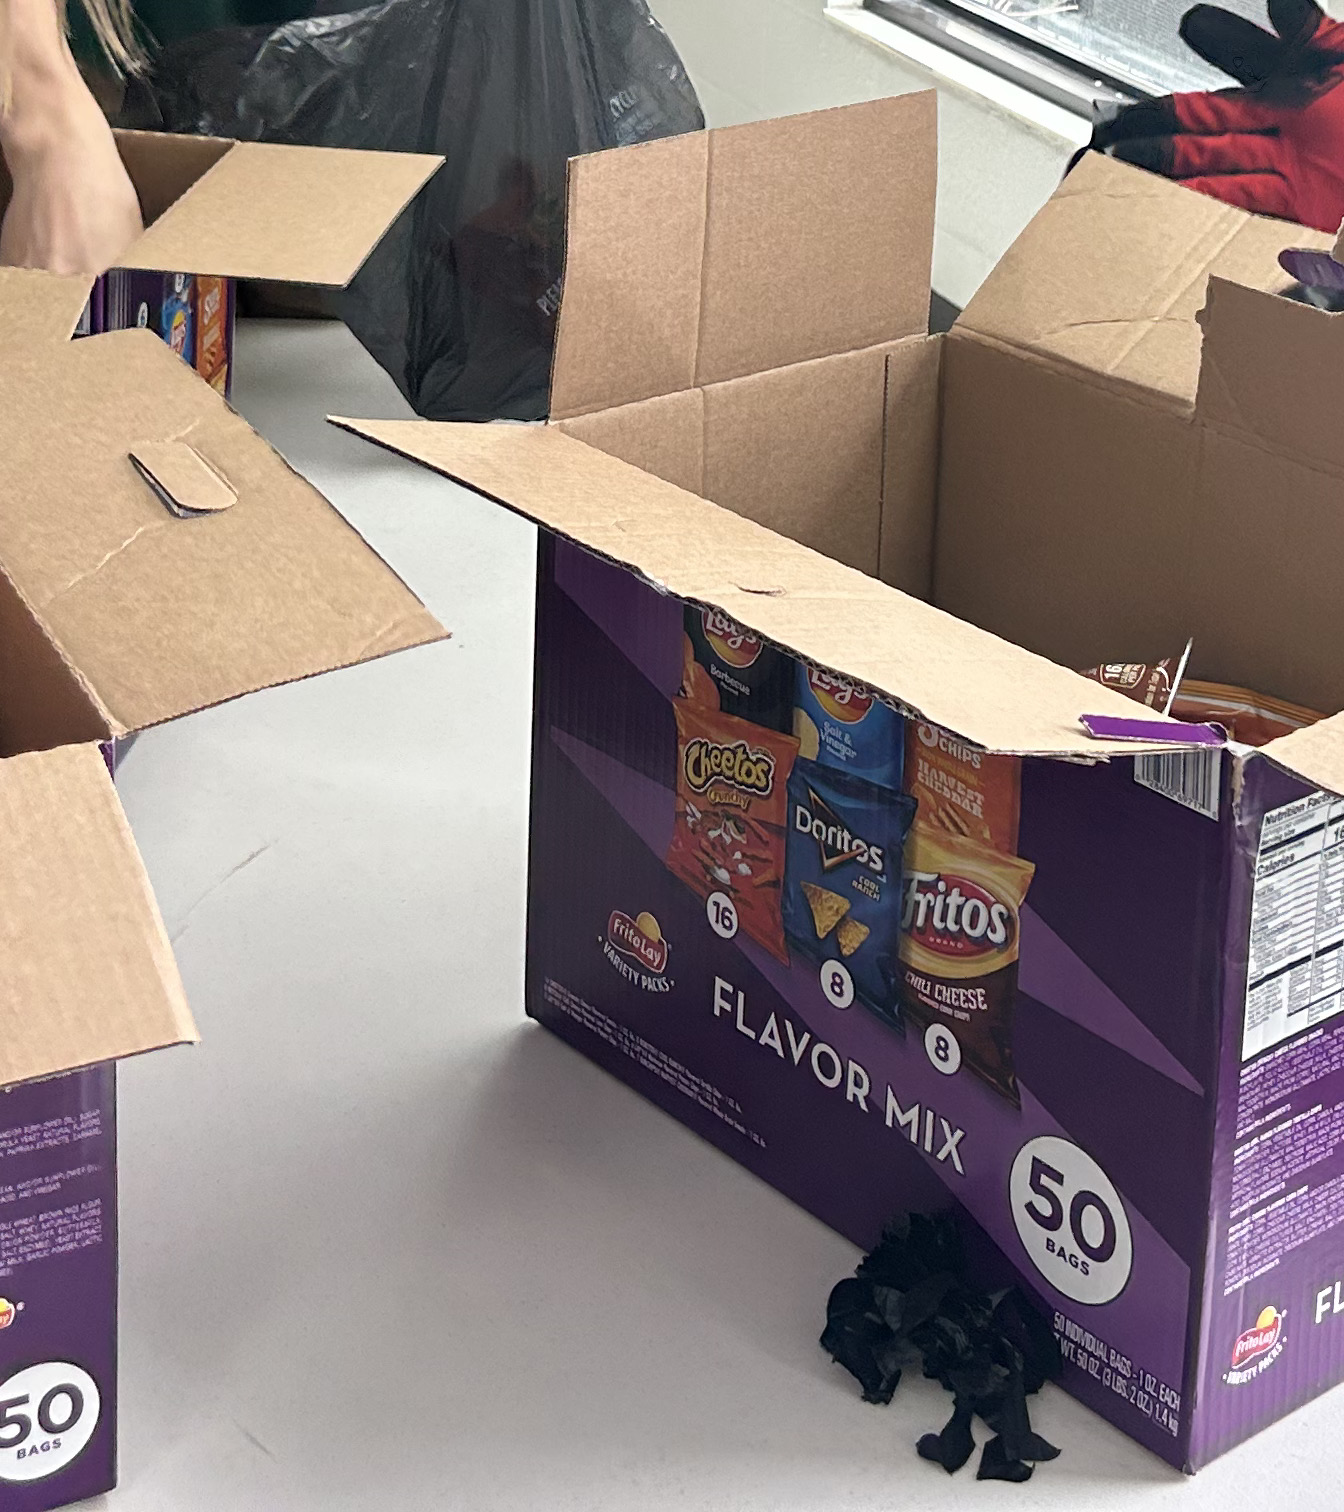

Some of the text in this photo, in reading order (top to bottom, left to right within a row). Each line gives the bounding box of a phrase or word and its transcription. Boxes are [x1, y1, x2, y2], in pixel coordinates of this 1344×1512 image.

[710, 664, 750, 695] Barbecue
[820, 730, 857, 758] Vinegar
[823, 721, 852, 745] Salt &
[684, 738, 772, 793] Cheetos
[939, 738, 982, 769] CHIPS
[917, 759, 985, 804] HARVEST
[917, 772, 984, 819] CHEDDAR
[708, 790, 751, 810] Crunchy
[1265, 802, 1305, 826] Nutrition
[795, 805, 884, 872] Doritos
[1257, 853, 1295, 876] Calories
[852, 880, 880, 901] RANCH
[859, 875, 880, 892] COOL
[712, 900, 733, 931] 16
[902, 870, 1009, 944] Fritos
[603, 941, 670, 992] VARIETY PACKS
[830, 973, 844, 997] 8
[906, 970, 988, 1011] CHILI CHEESE
[934, 1035, 950, 1063] 8
[713, 975, 870, 1113] FLAVOR
[885, 1084, 966, 1176] MIX
[1024, 1155, 1116, 1263] 50
[1046, 1237, 1091, 1277] BAGS
[1065, 1319, 1109, 1363] INDIVIDUAL
[1109, 1348, 1132, 1378] BAGS
[1139, 1369, 1144, 1387] 1
[1158, 1383, 1181, 1412] EACH
[1076, 1350, 1088, 1370] 50
[1102, 1367, 1112, 1387] (3
[1111, 1372, 1129, 1399] LBS.
[1129, 1385, 1136, 1404] 2
[1155, 1403, 1168, 1426] 1.4
[1168, 1411, 1179, 1437] kg
[16, 1438, 63, 1461] BAGS
